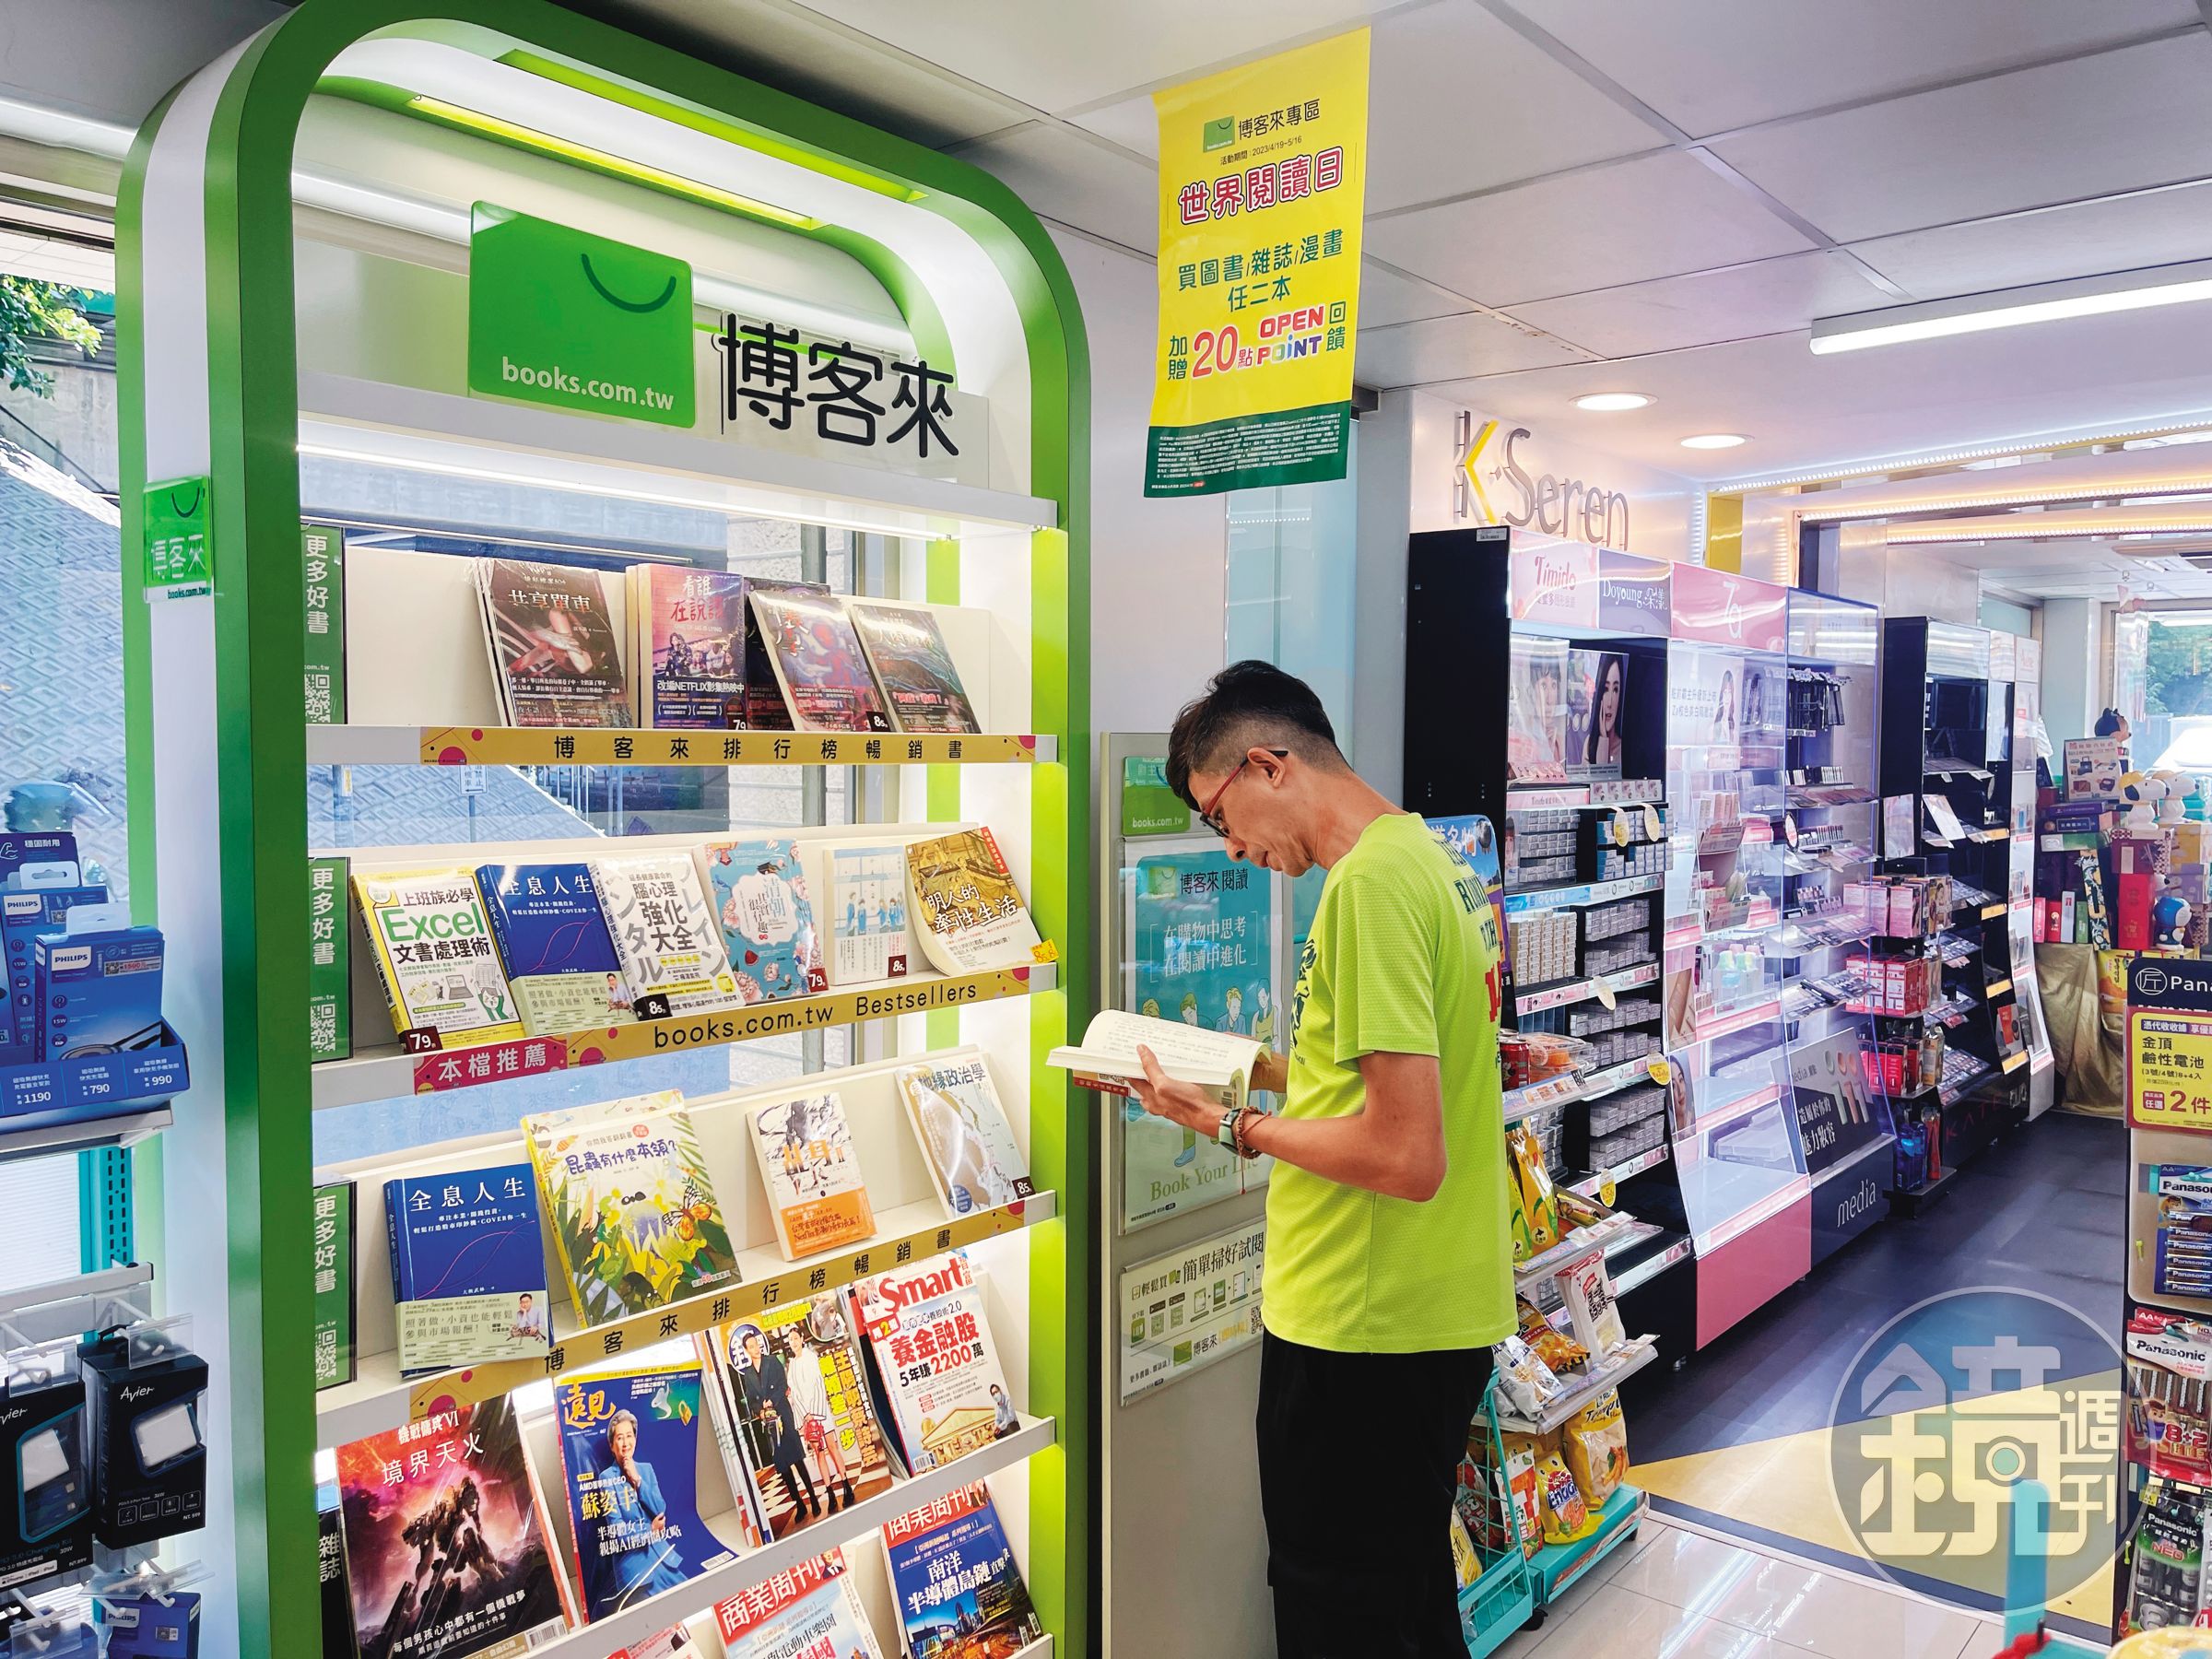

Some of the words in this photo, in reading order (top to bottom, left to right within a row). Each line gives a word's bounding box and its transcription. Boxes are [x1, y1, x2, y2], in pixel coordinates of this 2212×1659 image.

[1239, 99, 1321, 140] 博客來專區
[1178, 146, 1344, 226] 世界閱讀日
[1178, 229, 1344, 292] 買圖書/雜誌/漫畫
[1228, 275, 1291, 312] 任二本
[1259, 305, 1325, 339] OPEN
[501, 356, 675, 411] books.com.tw
[717, 312, 959, 459] 博客來
[167, 586, 213, 599] books.com.tw
[305, 534, 329, 634] 更多好書
[1603, 579, 1642, 609] Doyoung
[554, 735, 962, 759] 博客來排行榜暢銷書
[1132, 816, 1183, 829] books.com.tw
[403, 888, 475, 907] 上班族必學
[925, 883, 980, 913] 明人的
[312, 866, 335, 965] 更多好書
[382, 902, 485, 942] Excel
[639, 900, 688, 927] 強化
[935, 895, 1018, 937] 率性生活
[393, 936, 490, 965] 文書處理術
[651, 924, 698, 953] 大全
[54, 954, 88, 963] PHILIPS
[2171, 975, 2212, 993] Pan
[653, 1006, 833, 1049] books.com.tw
[855, 982, 977, 1017] Bestsellers
[2142, 1036, 2172, 1050] 金頂
[438, 1042, 547, 1082] 本檔推薦
[2142, 1052, 2204, 1069] 鹼性電池
[89, 1084, 110, 1094] 790
[151, 1075, 172, 1086] 990
[918, 1063, 986, 1091] 地緣政治學
[24, 1091, 52, 1104] 1190
[408, 1176, 526, 1213] 全息人生
[1150, 1173, 1191, 1202] Book
[1194, 1161, 1228, 1186] Your
[1837, 1178, 1877, 1229] media
[314, 1194, 337, 1294] 更多好書
[1183, 1231, 1264, 1284] 簡單掃好試閱
[2173, 1242, 2212, 1252] Panasonic
[2171, 1270, 2211, 1280] Panasonic
[2172, 1257, 2211, 1266] Panasonic
[878, 1257, 964, 1312] Smart
[2171, 1283, 2211, 1293] Panasonic
[545, 1230, 951, 1373] 博客來排行榜暢銷書
[2138, 1311, 2155, 1322] AA
[889, 1311, 980, 1369] 養金融股
[1193, 1334, 1218, 1357] 博客來
[2136, 1339, 2207, 1362] Panasonic
[120, 1385, 155, 1402] Avier
[560, 1378, 617, 1430] 遠見
[0, 1406, 29, 1427] vier
[2166, 1423, 2208, 1450] 8+2
[382, 1430, 485, 1488] 境界天火
[2147, 1512, 2199, 1537] Panasonic
[319, 1532, 342, 1583] 雜誌
[926, 1549, 962, 1583] 南洋
[720, 1557, 821, 1638] 商業周刊
